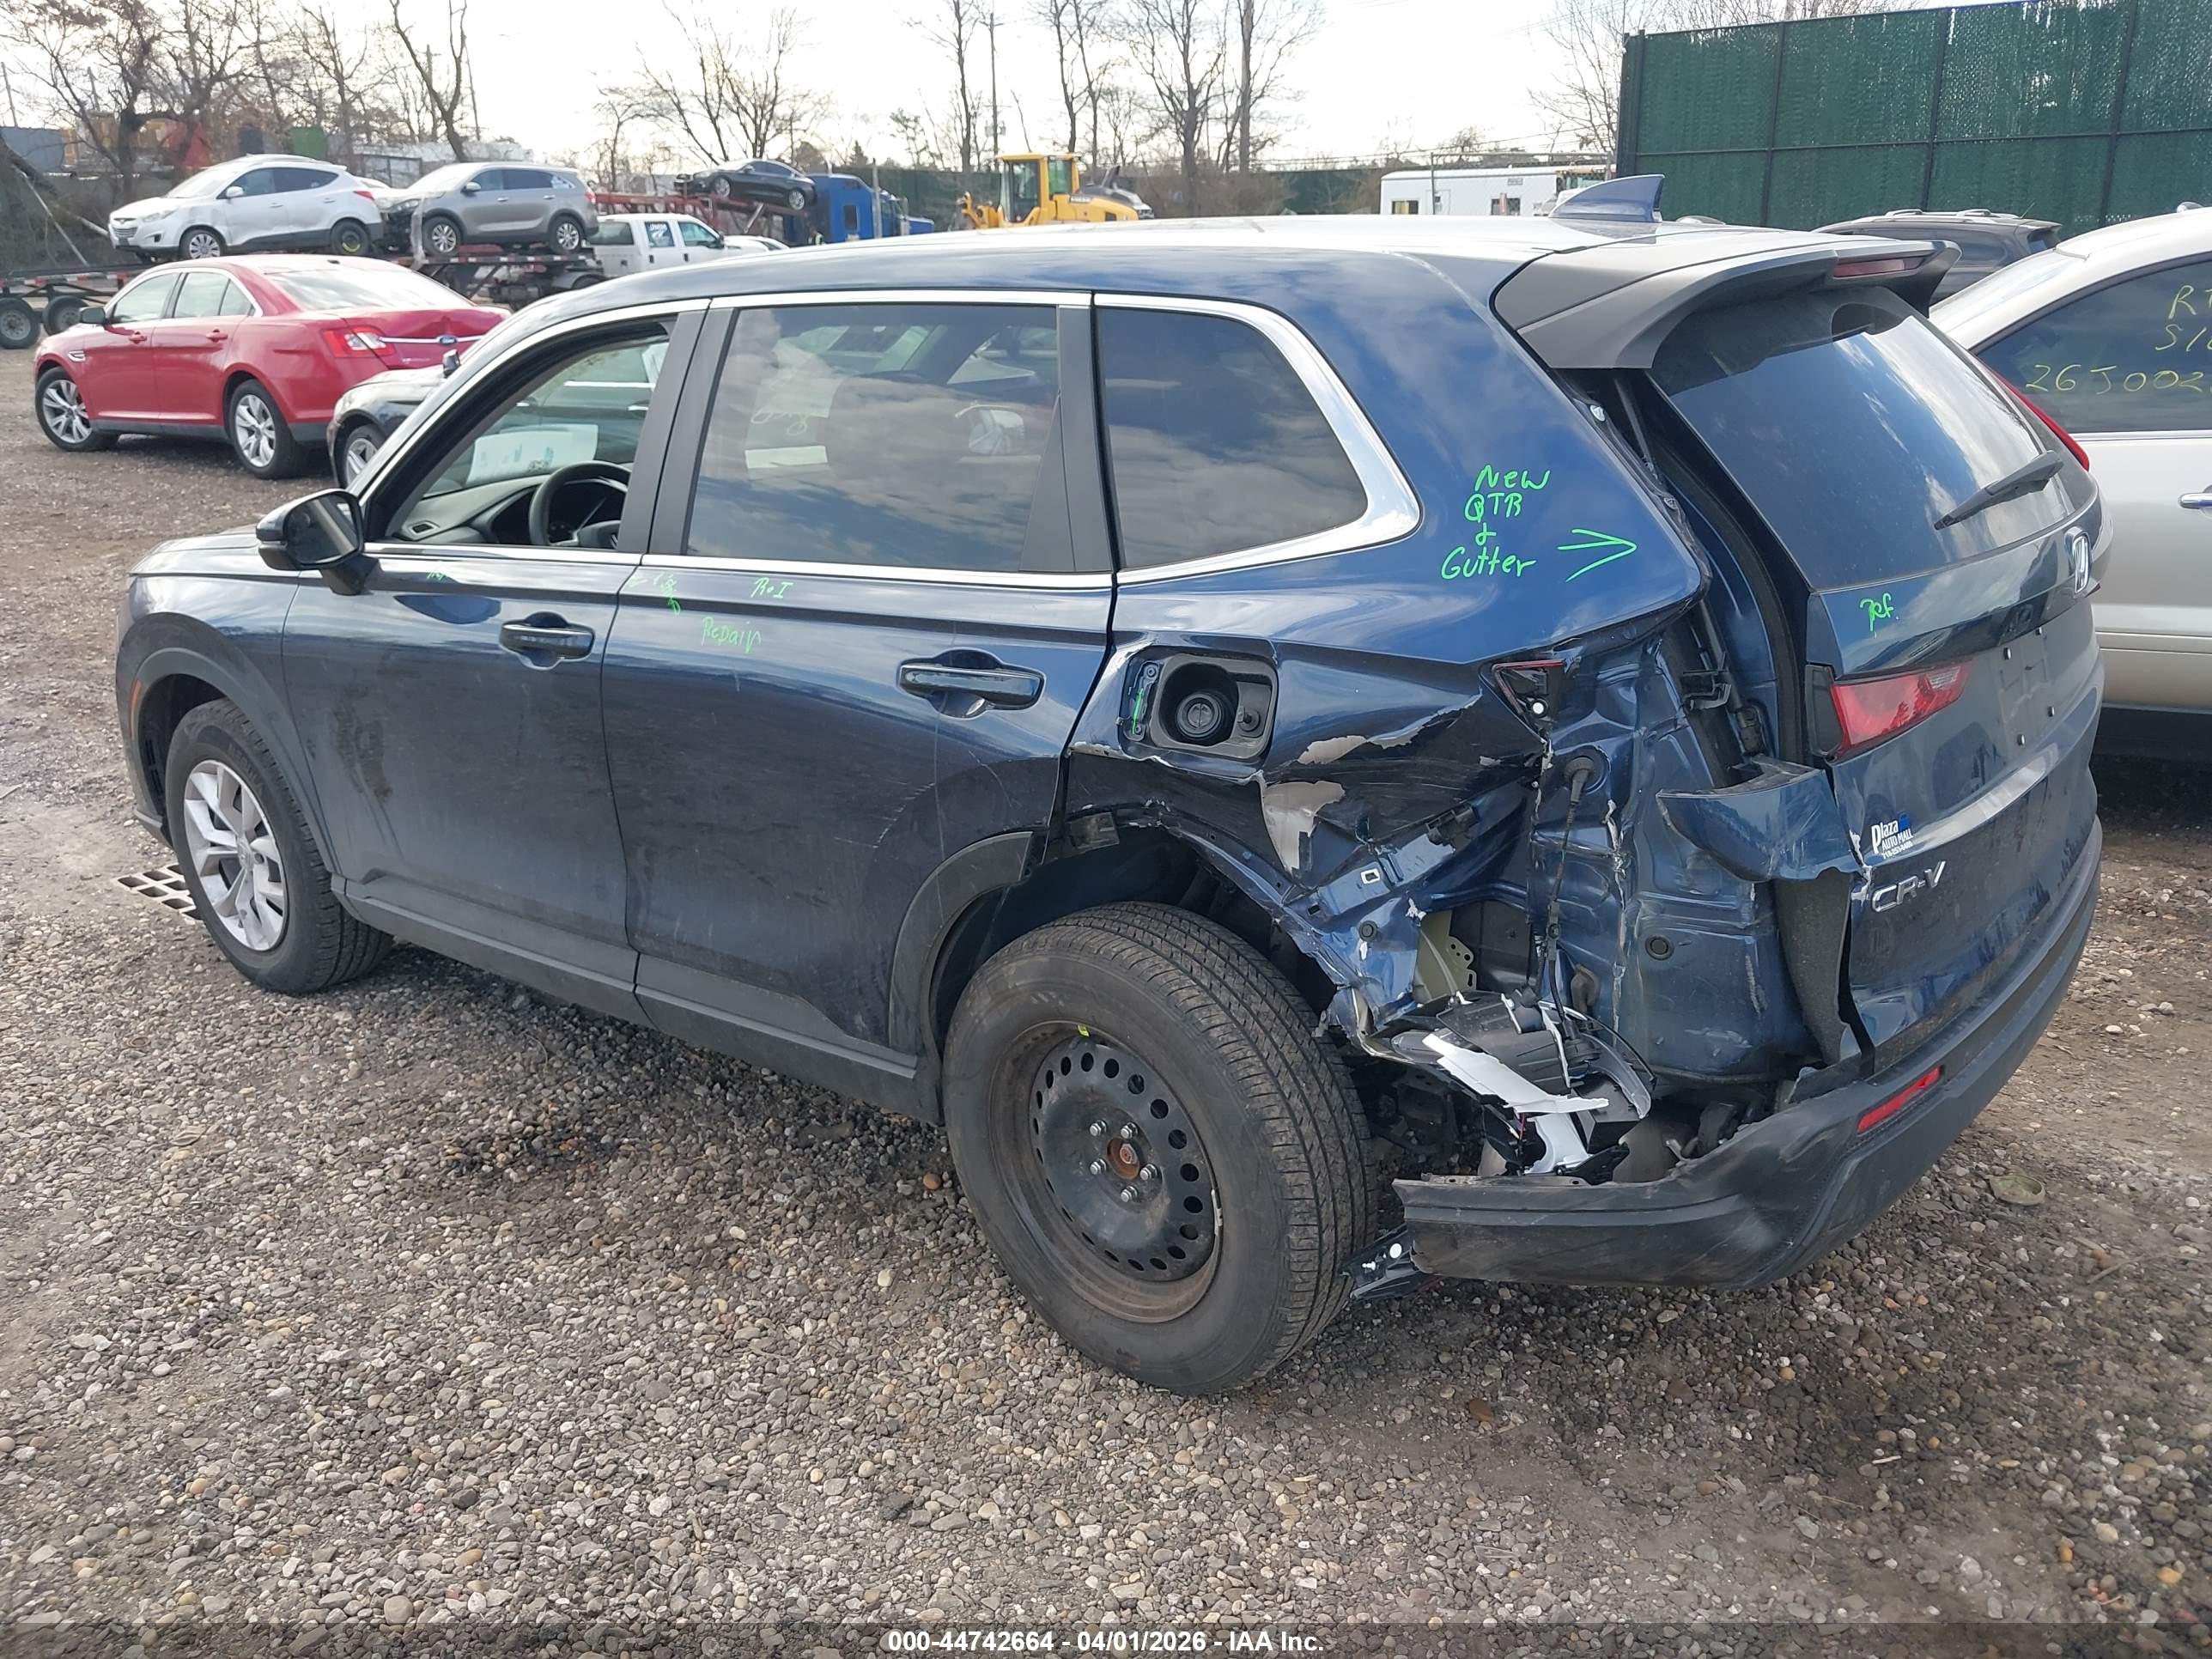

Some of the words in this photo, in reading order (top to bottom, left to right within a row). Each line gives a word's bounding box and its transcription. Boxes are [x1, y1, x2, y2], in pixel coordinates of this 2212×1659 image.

[2026, 364, 2212, 395] 26J002
[1441, 546, 1537, 580] Gutter
[1871, 819, 1899, 854] Plaza
[1881, 835, 1899, 851] AUTO
[1898, 828, 1914, 845] MALL
[1872, 860, 1947, 912] CR-V
